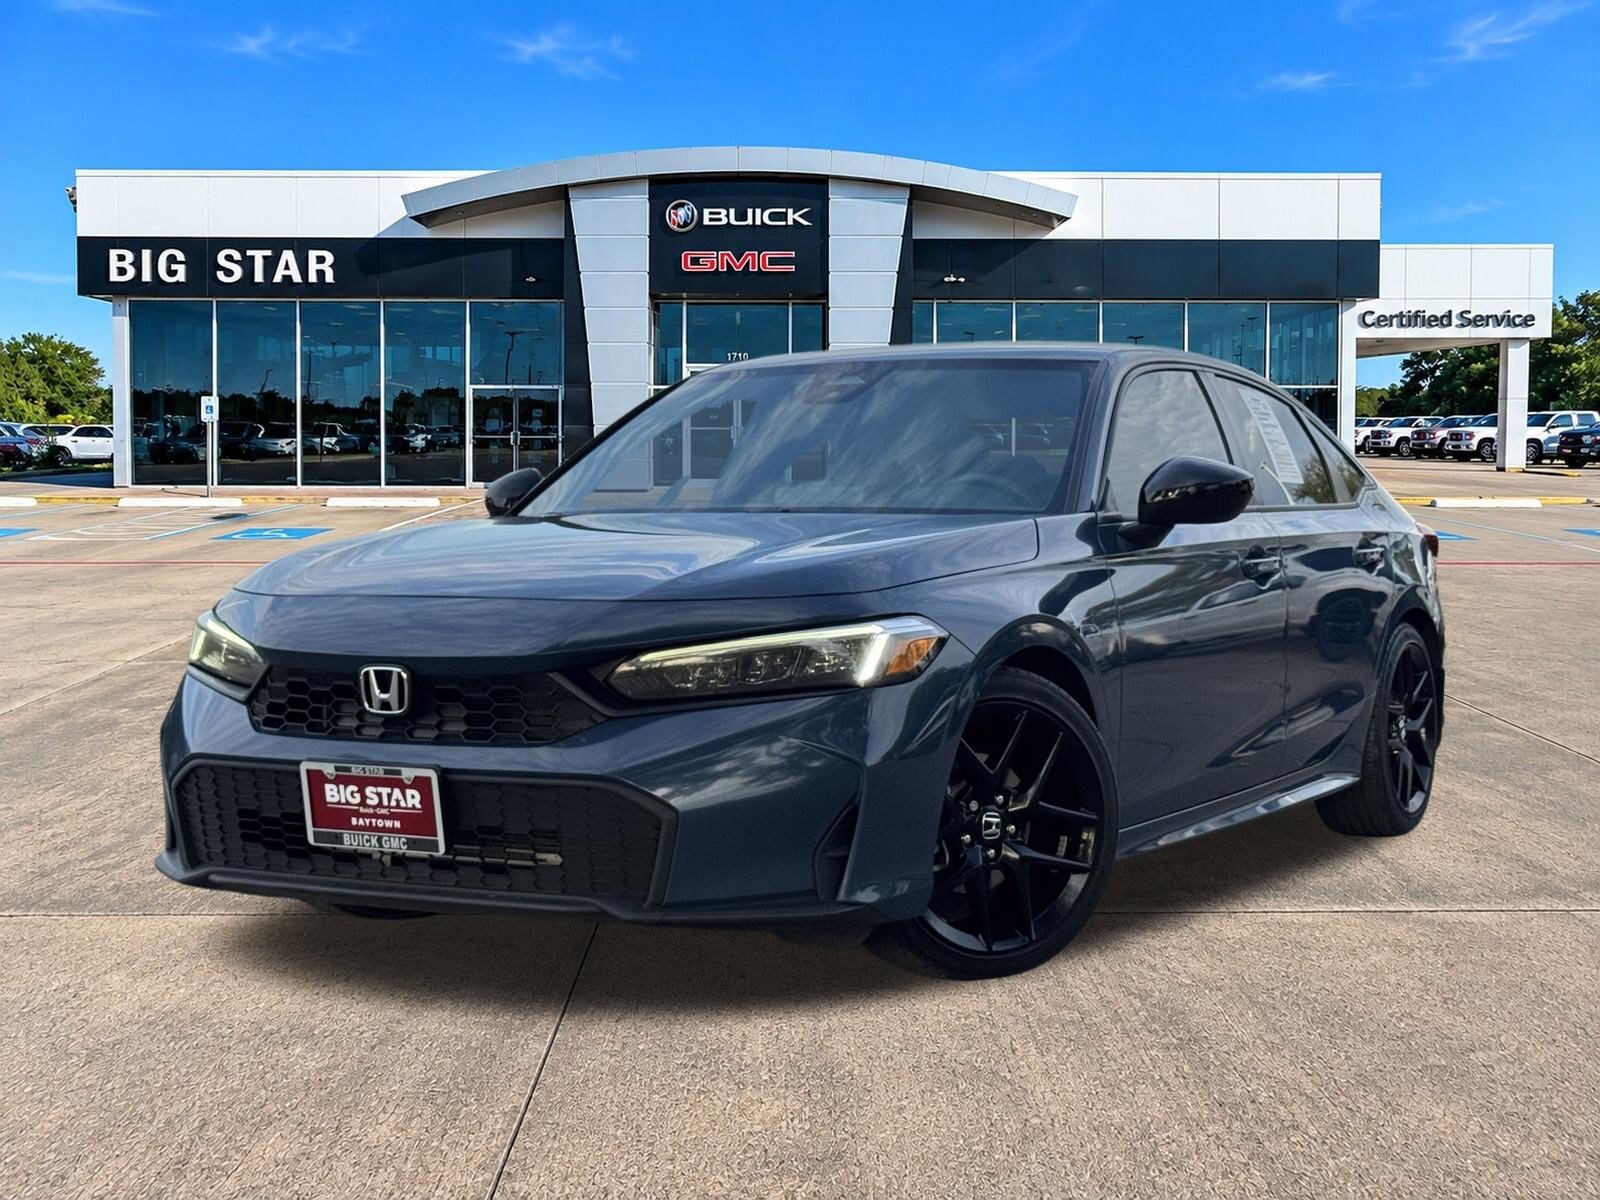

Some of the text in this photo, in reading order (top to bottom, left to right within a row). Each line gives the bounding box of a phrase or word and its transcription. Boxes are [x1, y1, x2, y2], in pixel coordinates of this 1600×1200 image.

[703, 208, 813, 226] BUICK
[108, 248, 336, 283] BIG STAR
[681, 251, 796, 272] GMC
[1360, 310, 1536, 328] Certified Service
[324, 783, 422, 809] BIG STAR
[351, 817, 401, 828] BAYTOWN
[343, 833, 408, 850] BUICK GMC
